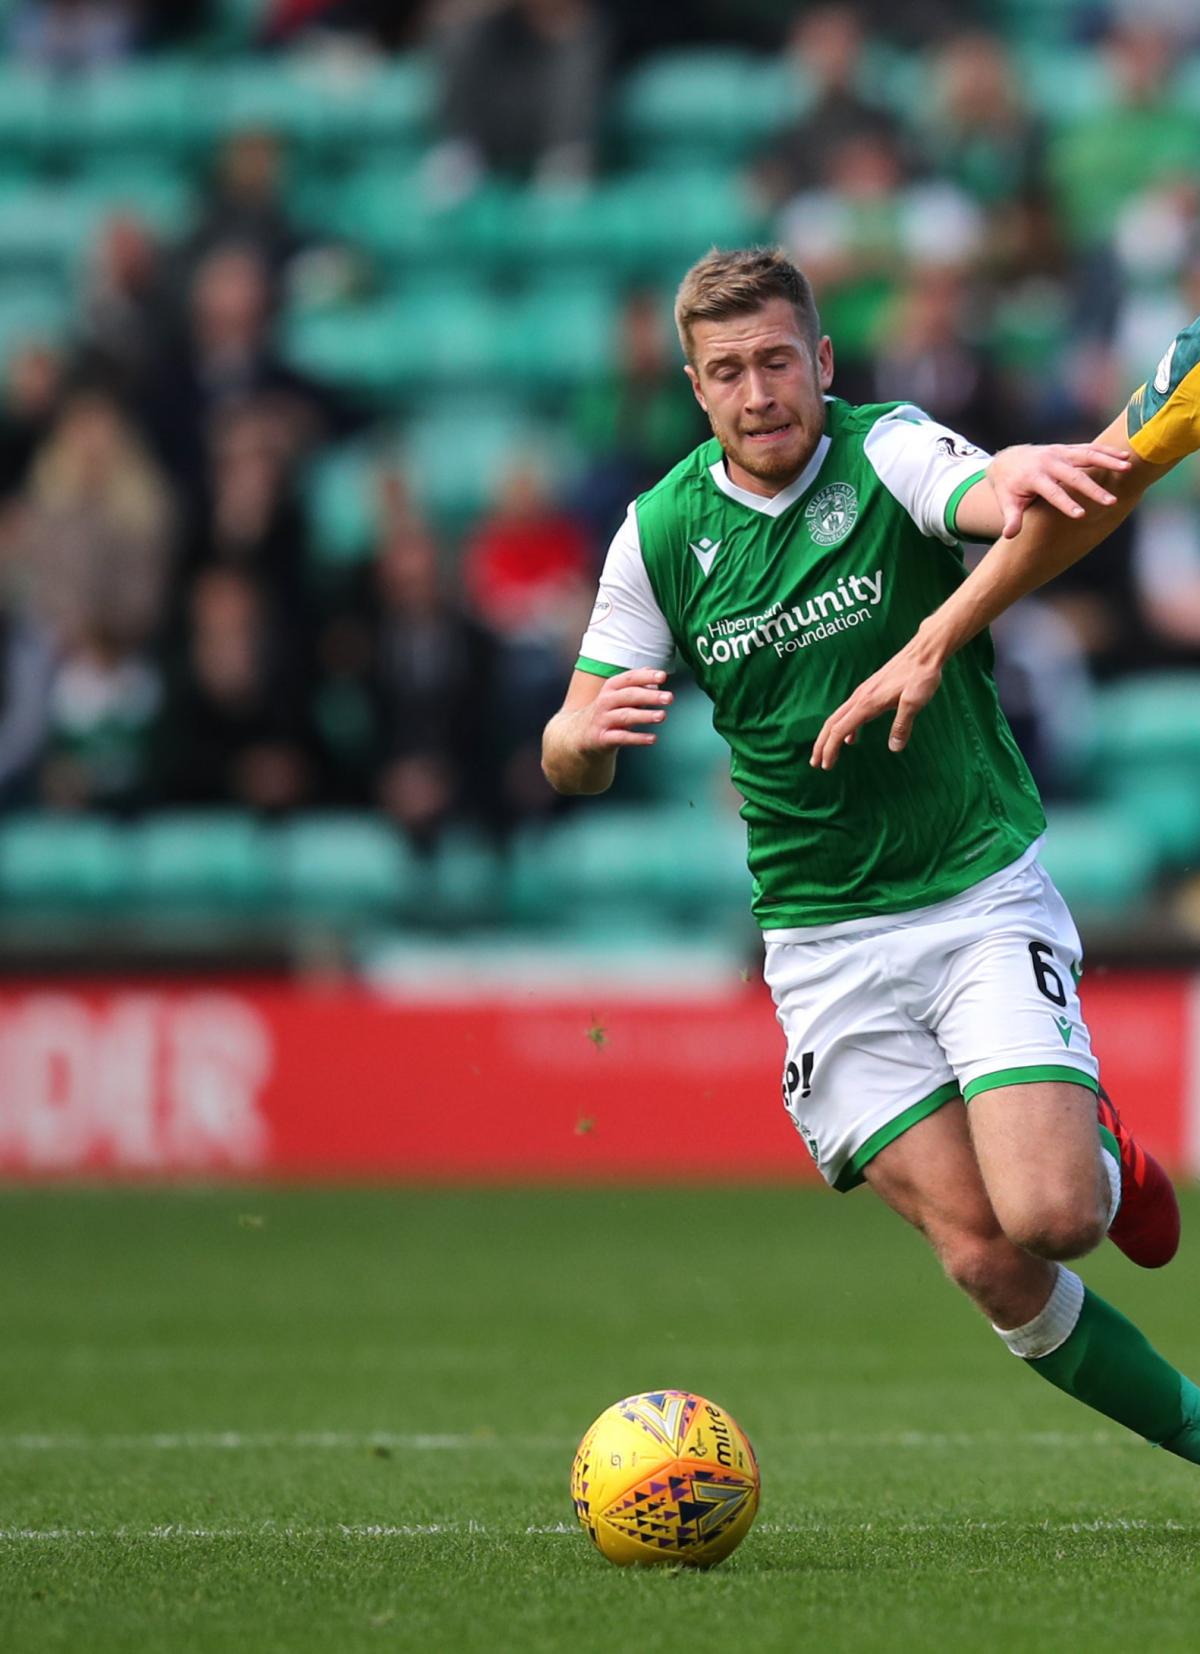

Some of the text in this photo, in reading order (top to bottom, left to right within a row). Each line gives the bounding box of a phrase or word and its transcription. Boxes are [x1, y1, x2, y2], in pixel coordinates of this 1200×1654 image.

[696, 570, 882, 665] Community
[773, 607, 872, 658] Foundation
[1028, 942, 1067, 1008] 6
[705, 1405, 731, 1467] mitre
